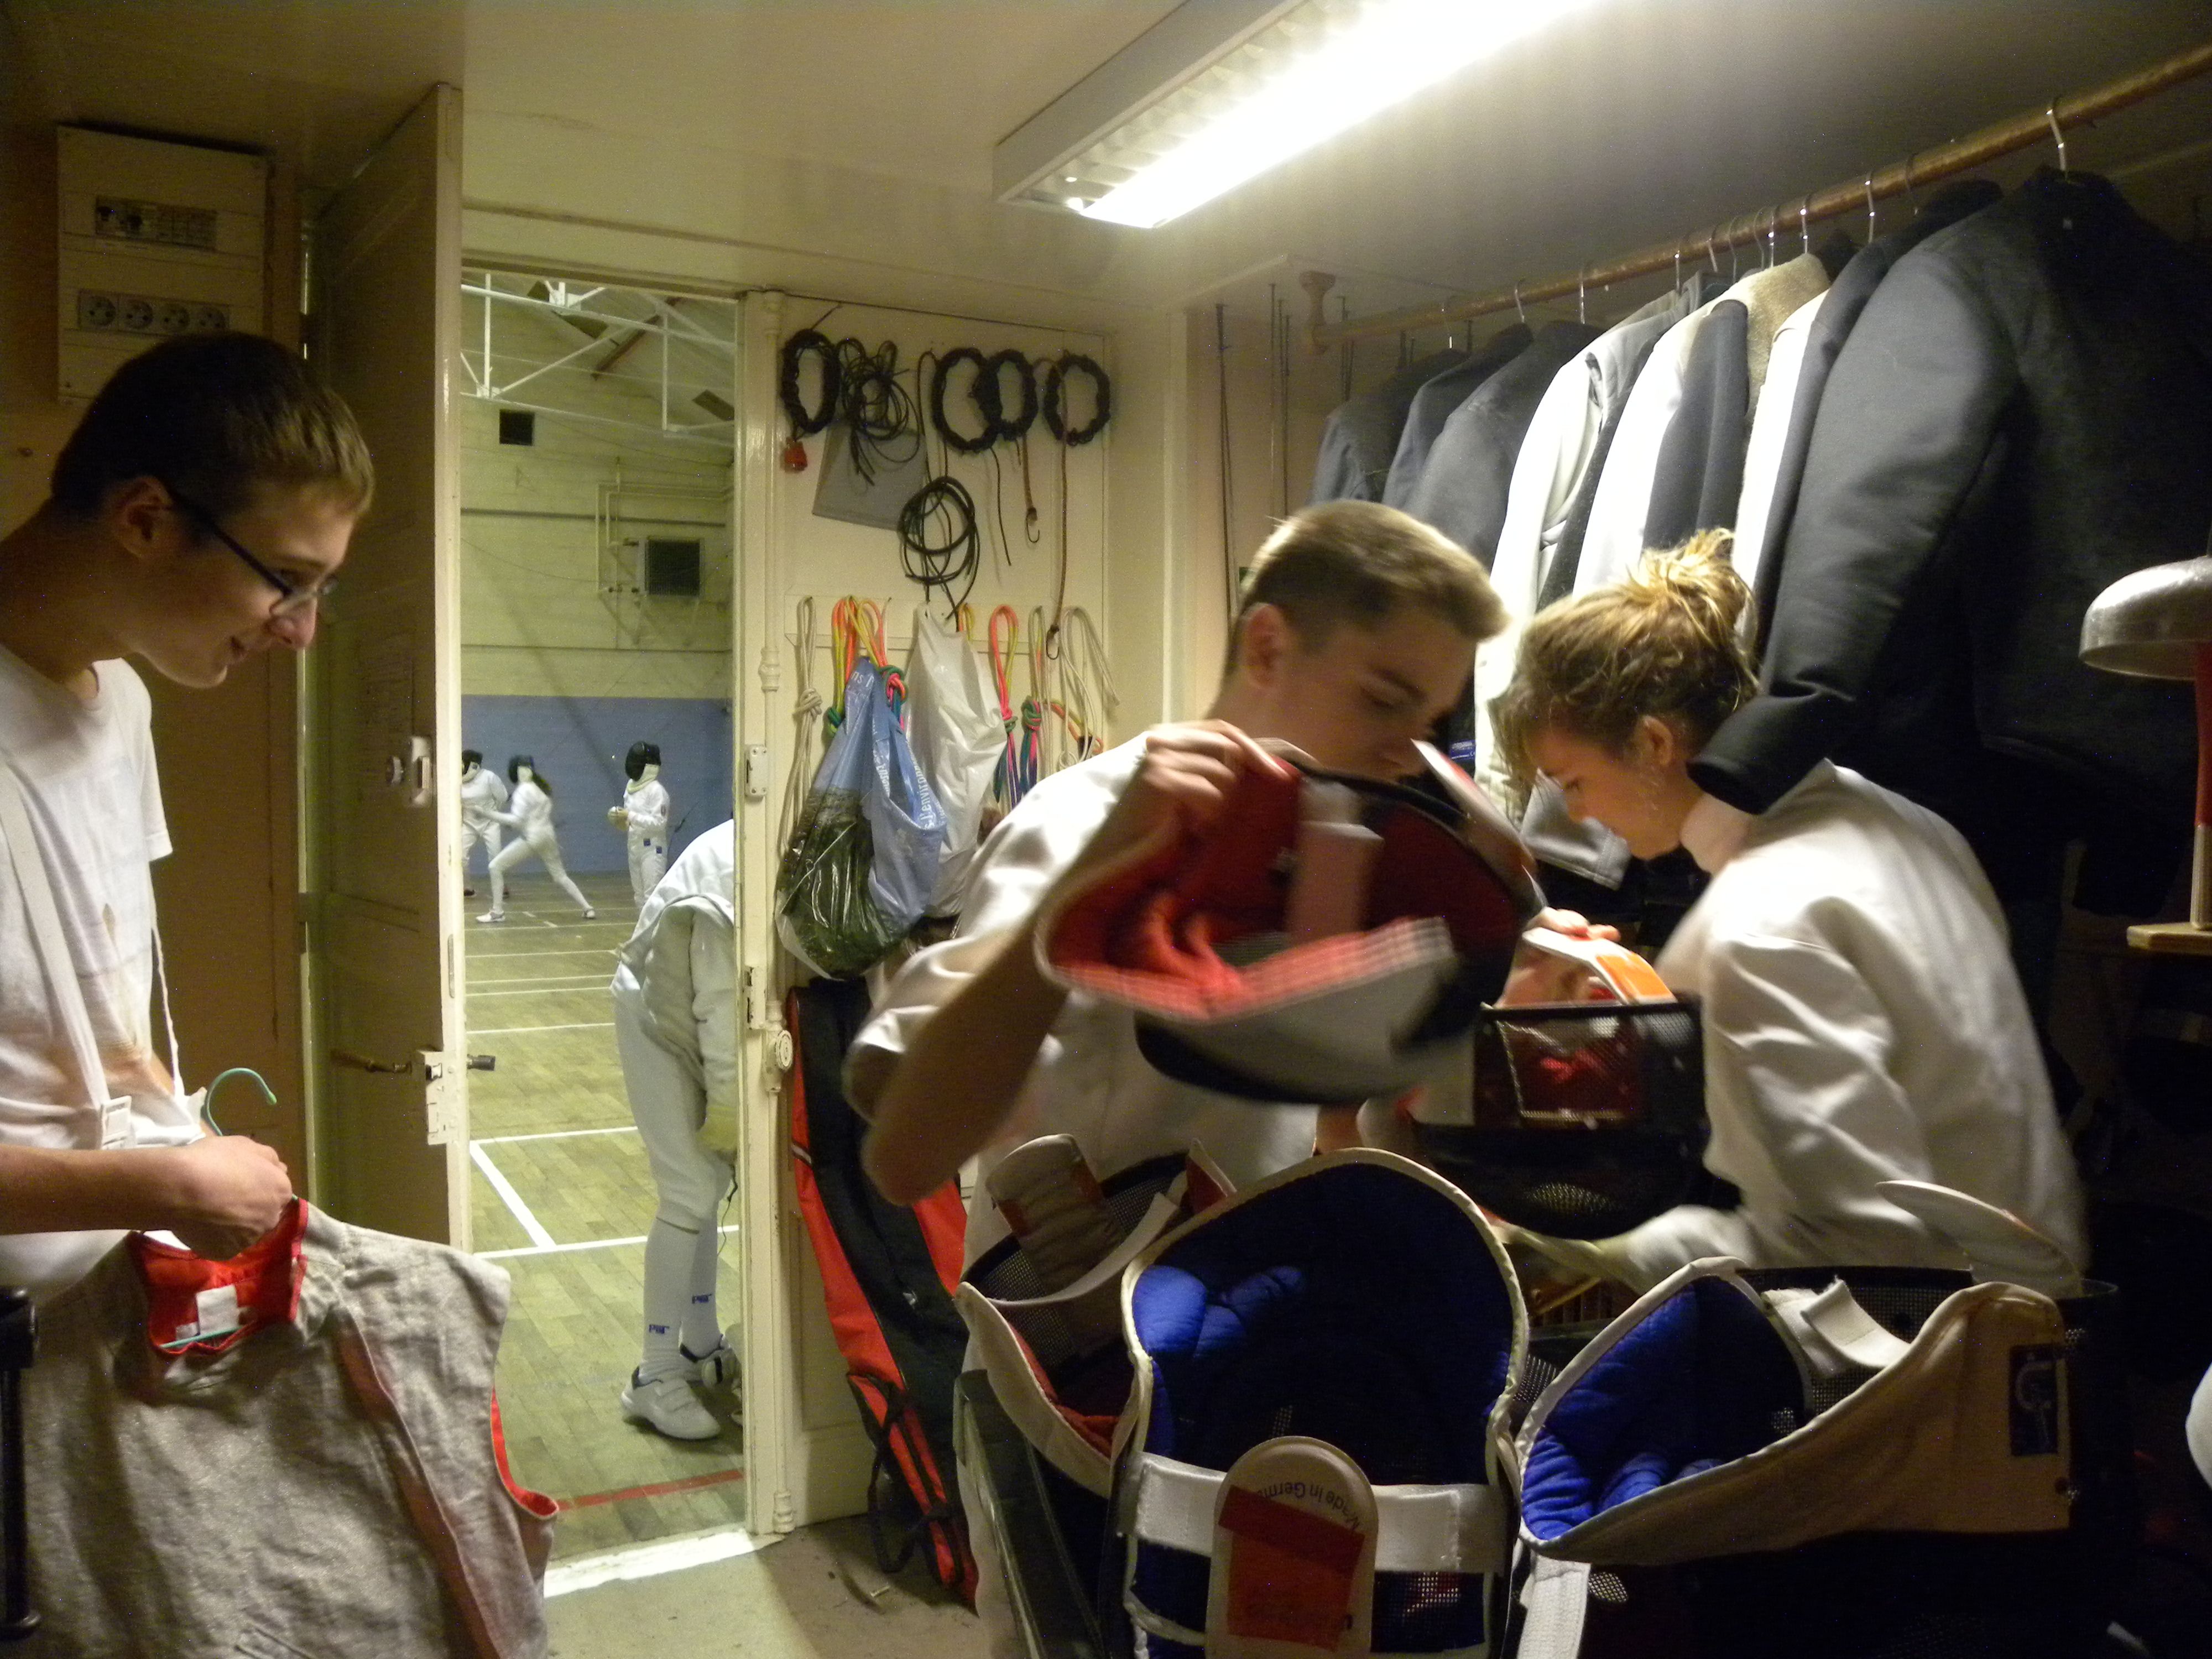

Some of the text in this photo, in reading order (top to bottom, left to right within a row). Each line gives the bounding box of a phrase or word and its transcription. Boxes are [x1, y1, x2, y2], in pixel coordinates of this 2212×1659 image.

[1257, 1481, 1361, 1531] Made in Germ
